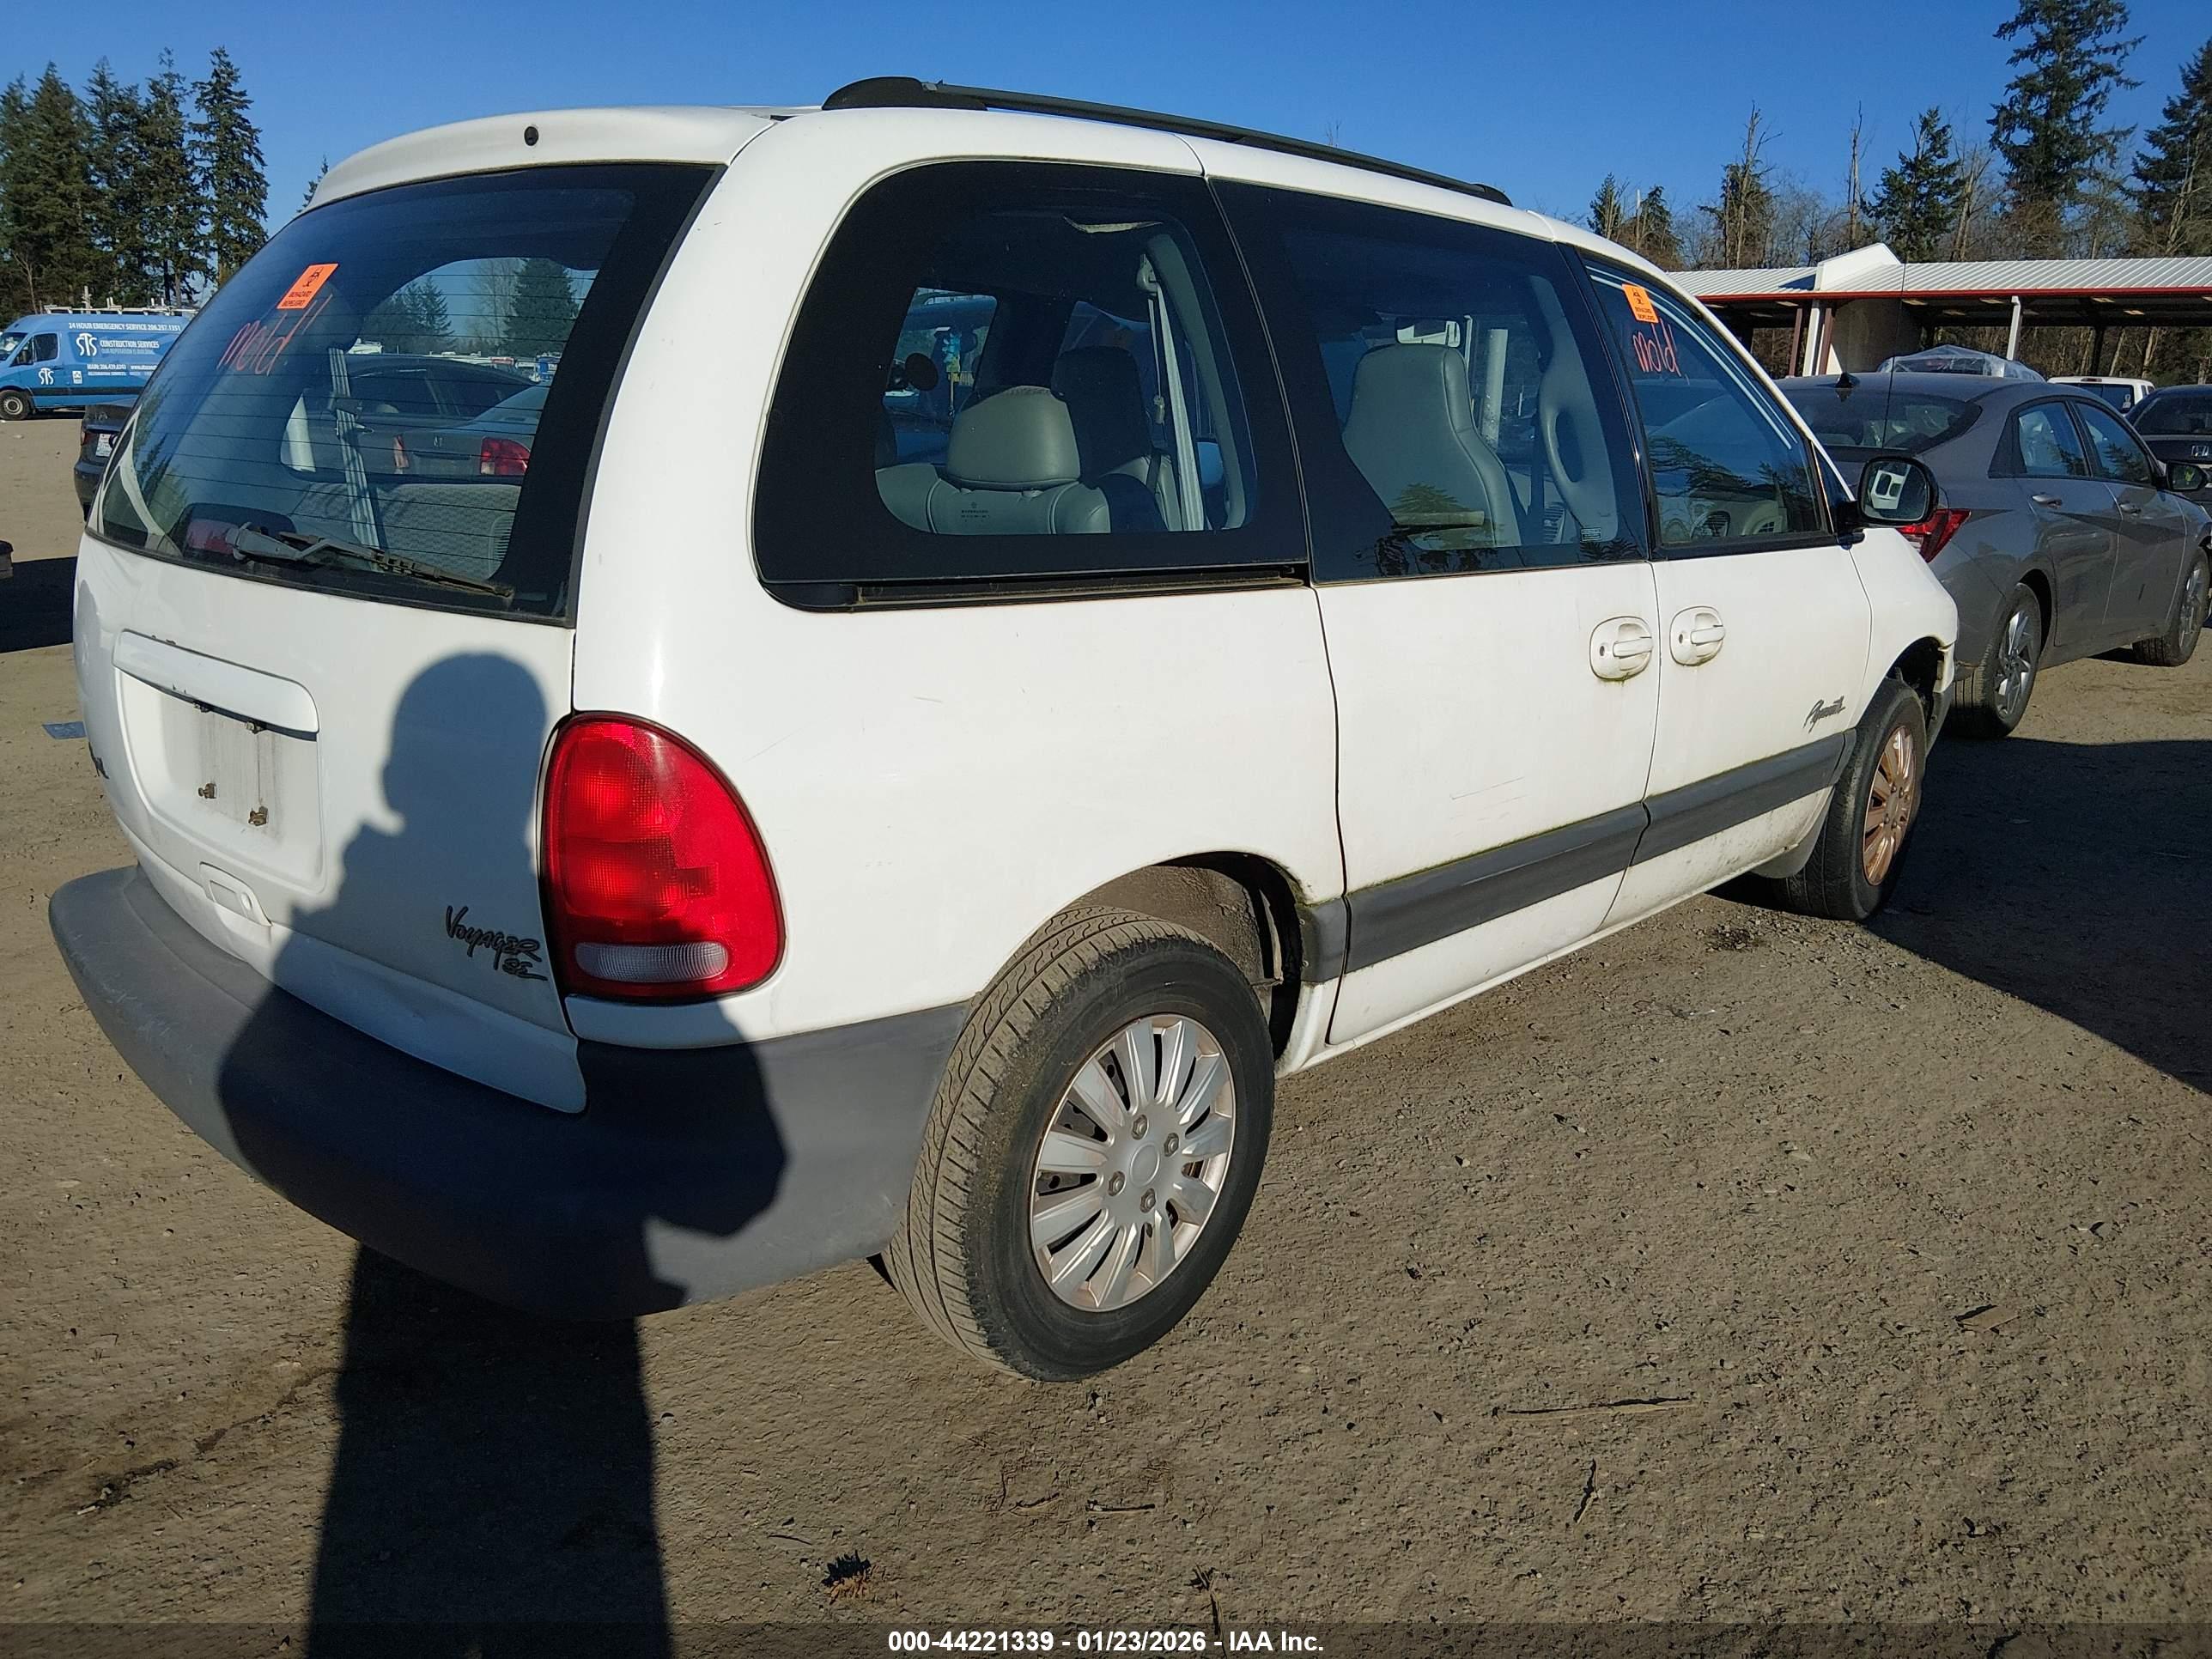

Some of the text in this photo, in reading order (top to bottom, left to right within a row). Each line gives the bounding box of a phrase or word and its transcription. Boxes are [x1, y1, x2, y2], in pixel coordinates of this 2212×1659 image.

[76, 332, 98, 356] STS
[137, 340, 160, 349] SERVICES
[38, 368, 54, 385] STS
